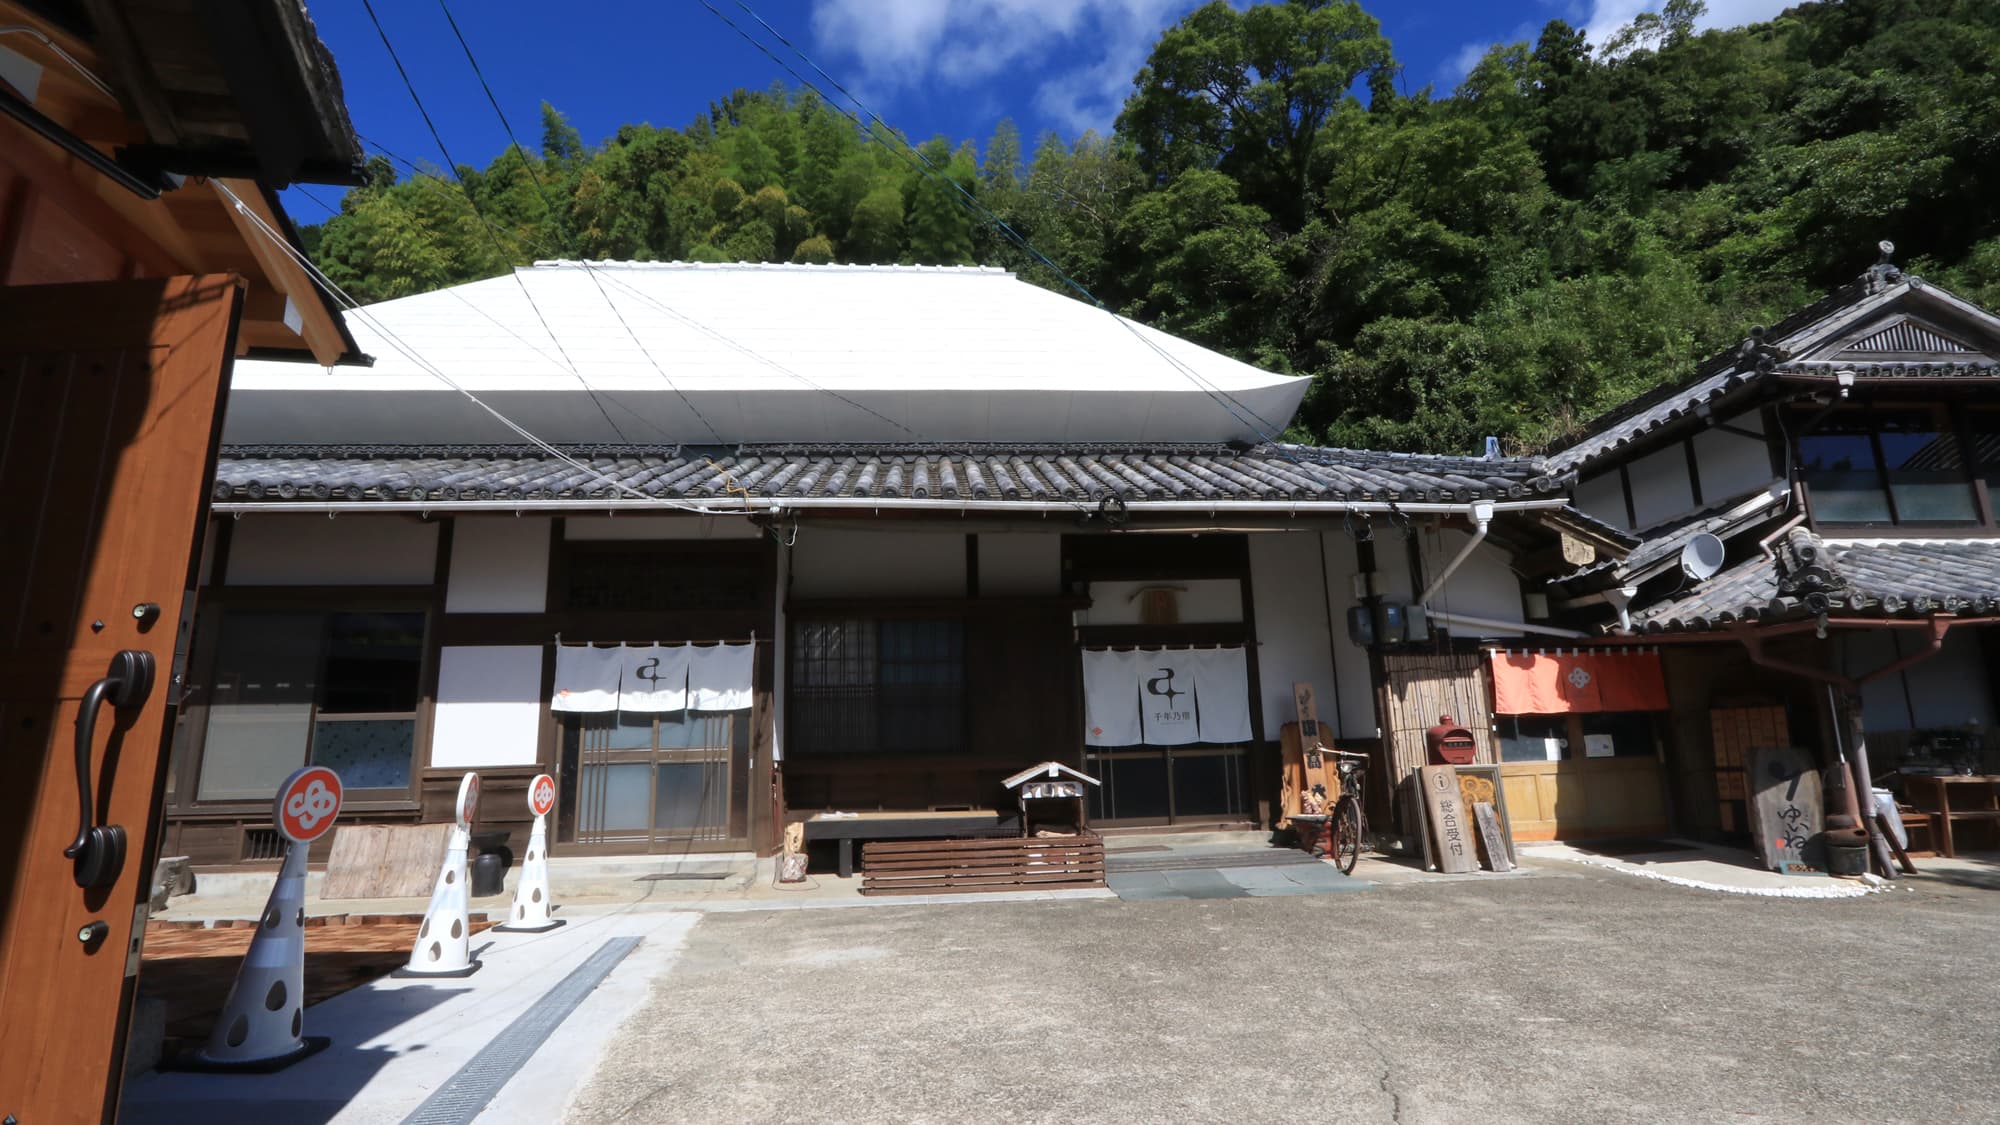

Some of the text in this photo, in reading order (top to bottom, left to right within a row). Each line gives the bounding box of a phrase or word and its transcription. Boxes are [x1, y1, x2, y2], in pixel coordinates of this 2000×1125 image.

[1440, 799, 1463, 857] 総合受付
[1777, 804, 1809, 849] ゆいね
